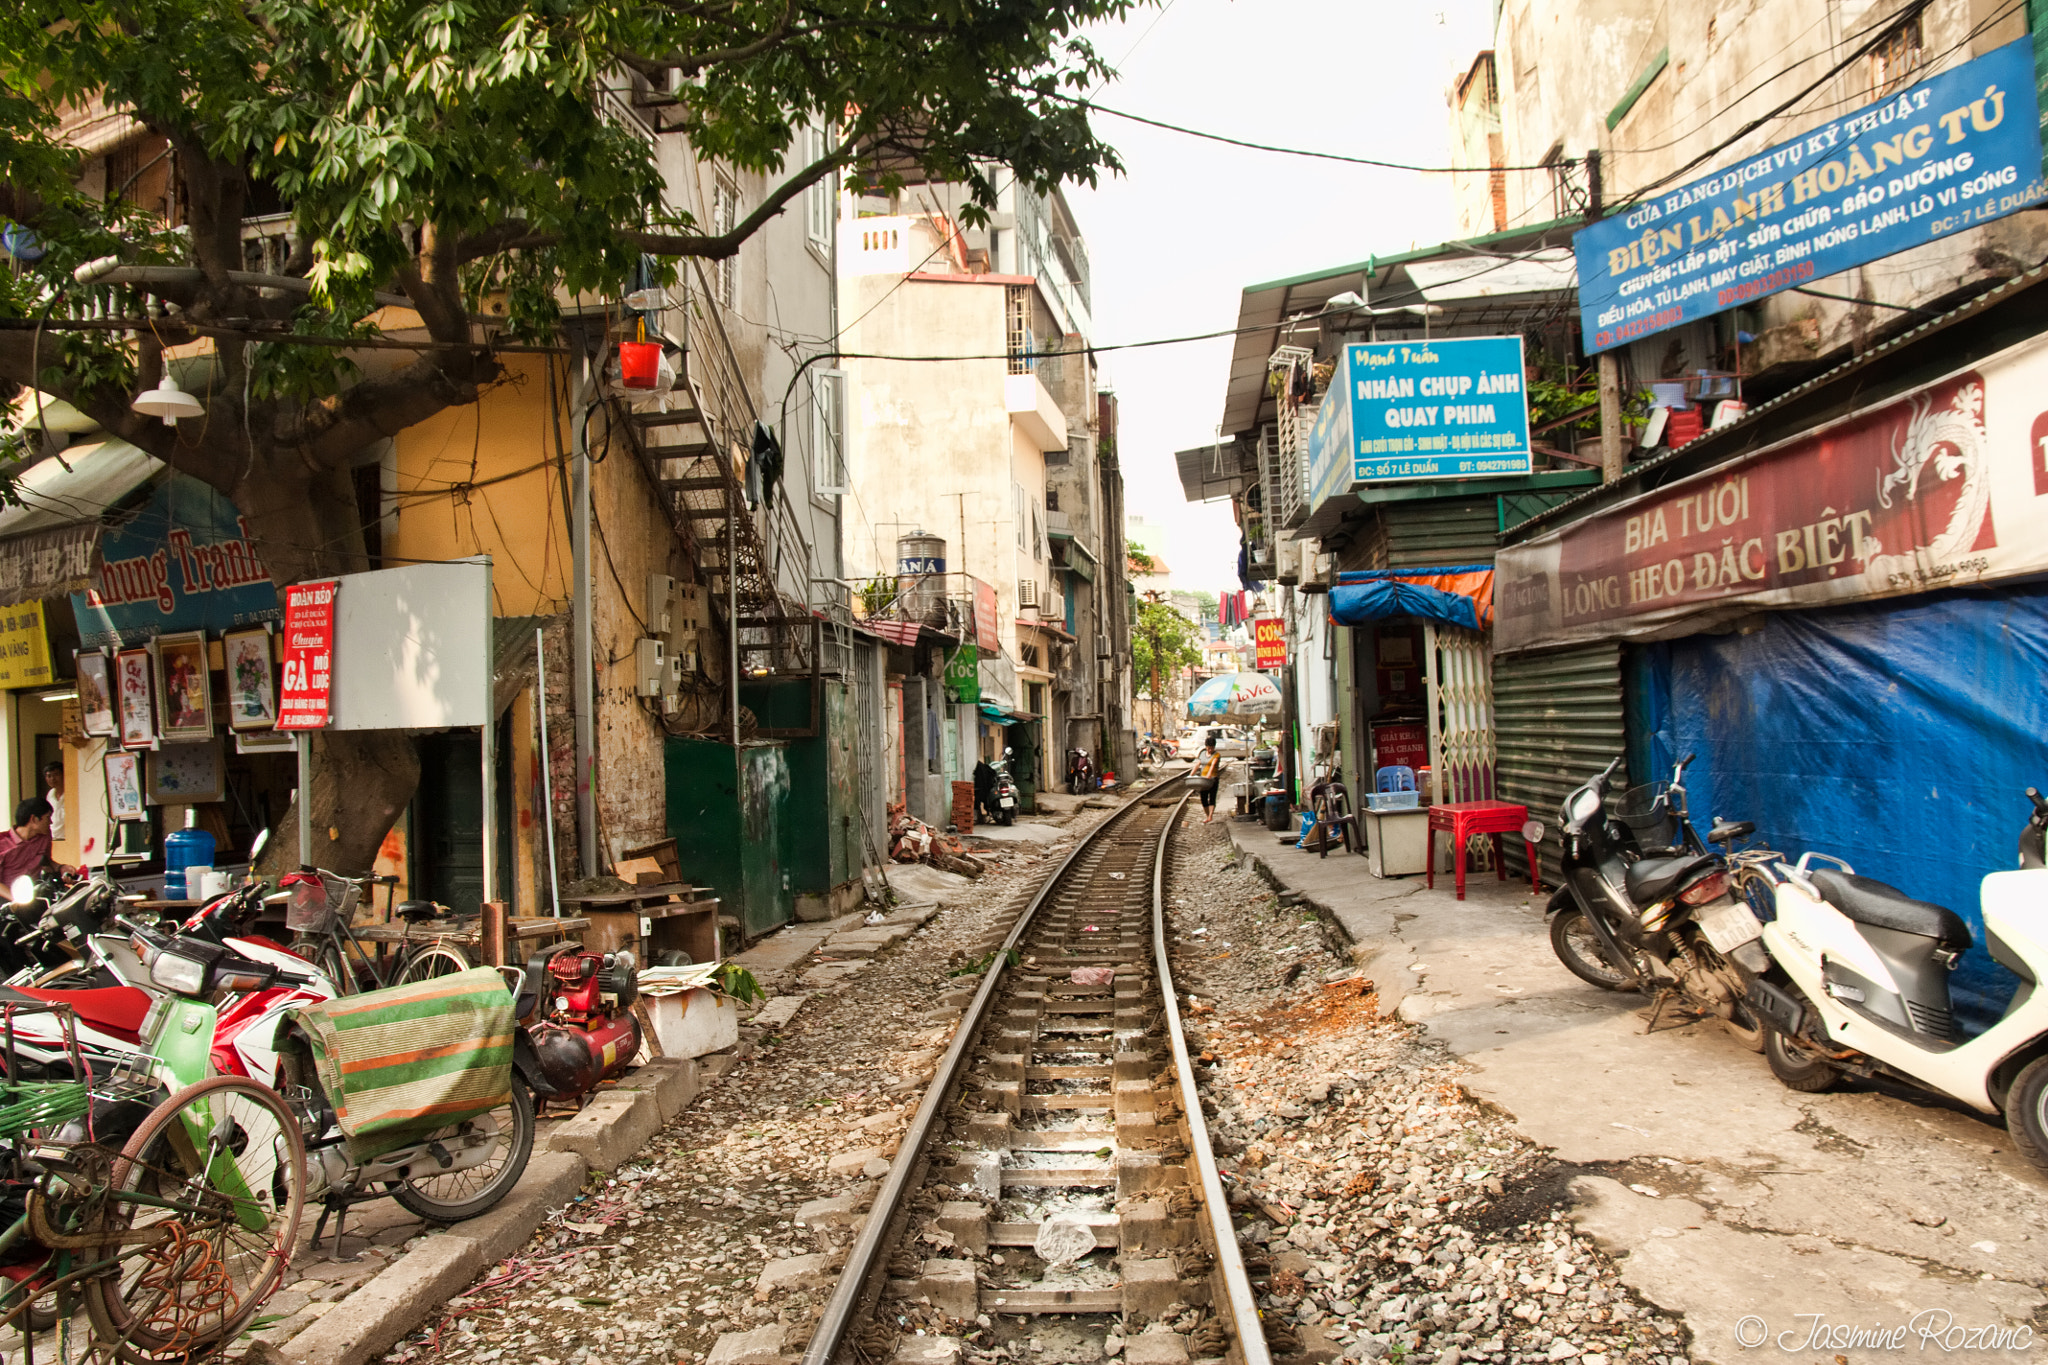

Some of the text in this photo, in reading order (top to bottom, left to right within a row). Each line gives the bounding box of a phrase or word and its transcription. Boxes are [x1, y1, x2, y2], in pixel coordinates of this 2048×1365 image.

[1626, 202, 1662, 229] CỬA
[1665, 179, 1722, 215] HÀNG
[1722, 158, 1773, 192] DỊCH
[1772, 142, 1803, 168] VỤ
[1844, 87, 1932, 139] THUẬT
[1608, 84, 2006, 277] ĐIỆN LẠNH HOÀNG TÚ
[1747, 224, 1781, 249] SỬA
[1842, 185, 1885, 215] BẢO
[1888, 152, 1974, 197] DƯỠNG
[1776, 241, 1811, 265] BÌNH
[1813, 222, 1858, 251] NÓNG
[1860, 204, 1910, 236] LẠNH,
[1911, 194, 1934, 218] LÒ
[1937, 186, 1958, 207] VI
[1960, 166, 2017, 200] SÓNG
[1962, 210, 1972, 224] 7
[1975, 198, 1997, 220] LÊ
[1355, 343, 1440, 371] Mạnh Tuấn
[1357, 370, 1520, 403] NHẬN CHỤP ẢNH
[1384, 404, 1497, 428] QUAY PHIM
[1391, 465, 1397, 474] 7
[1399, 462, 1411, 474] LÊ
[1624, 475, 1749, 554] BIA TƯƠI
[1562, 506, 1872, 618] LÒNG HEO ĐẶC BIỆT
[290, 586, 332, 607] HOÀN BÉO
[283, 650, 308, 691] GÀ
[313, 649, 330, 671] MỔ
[312, 671, 330, 692] LUỘC
[1396, 743, 1424, 754] CHANH
